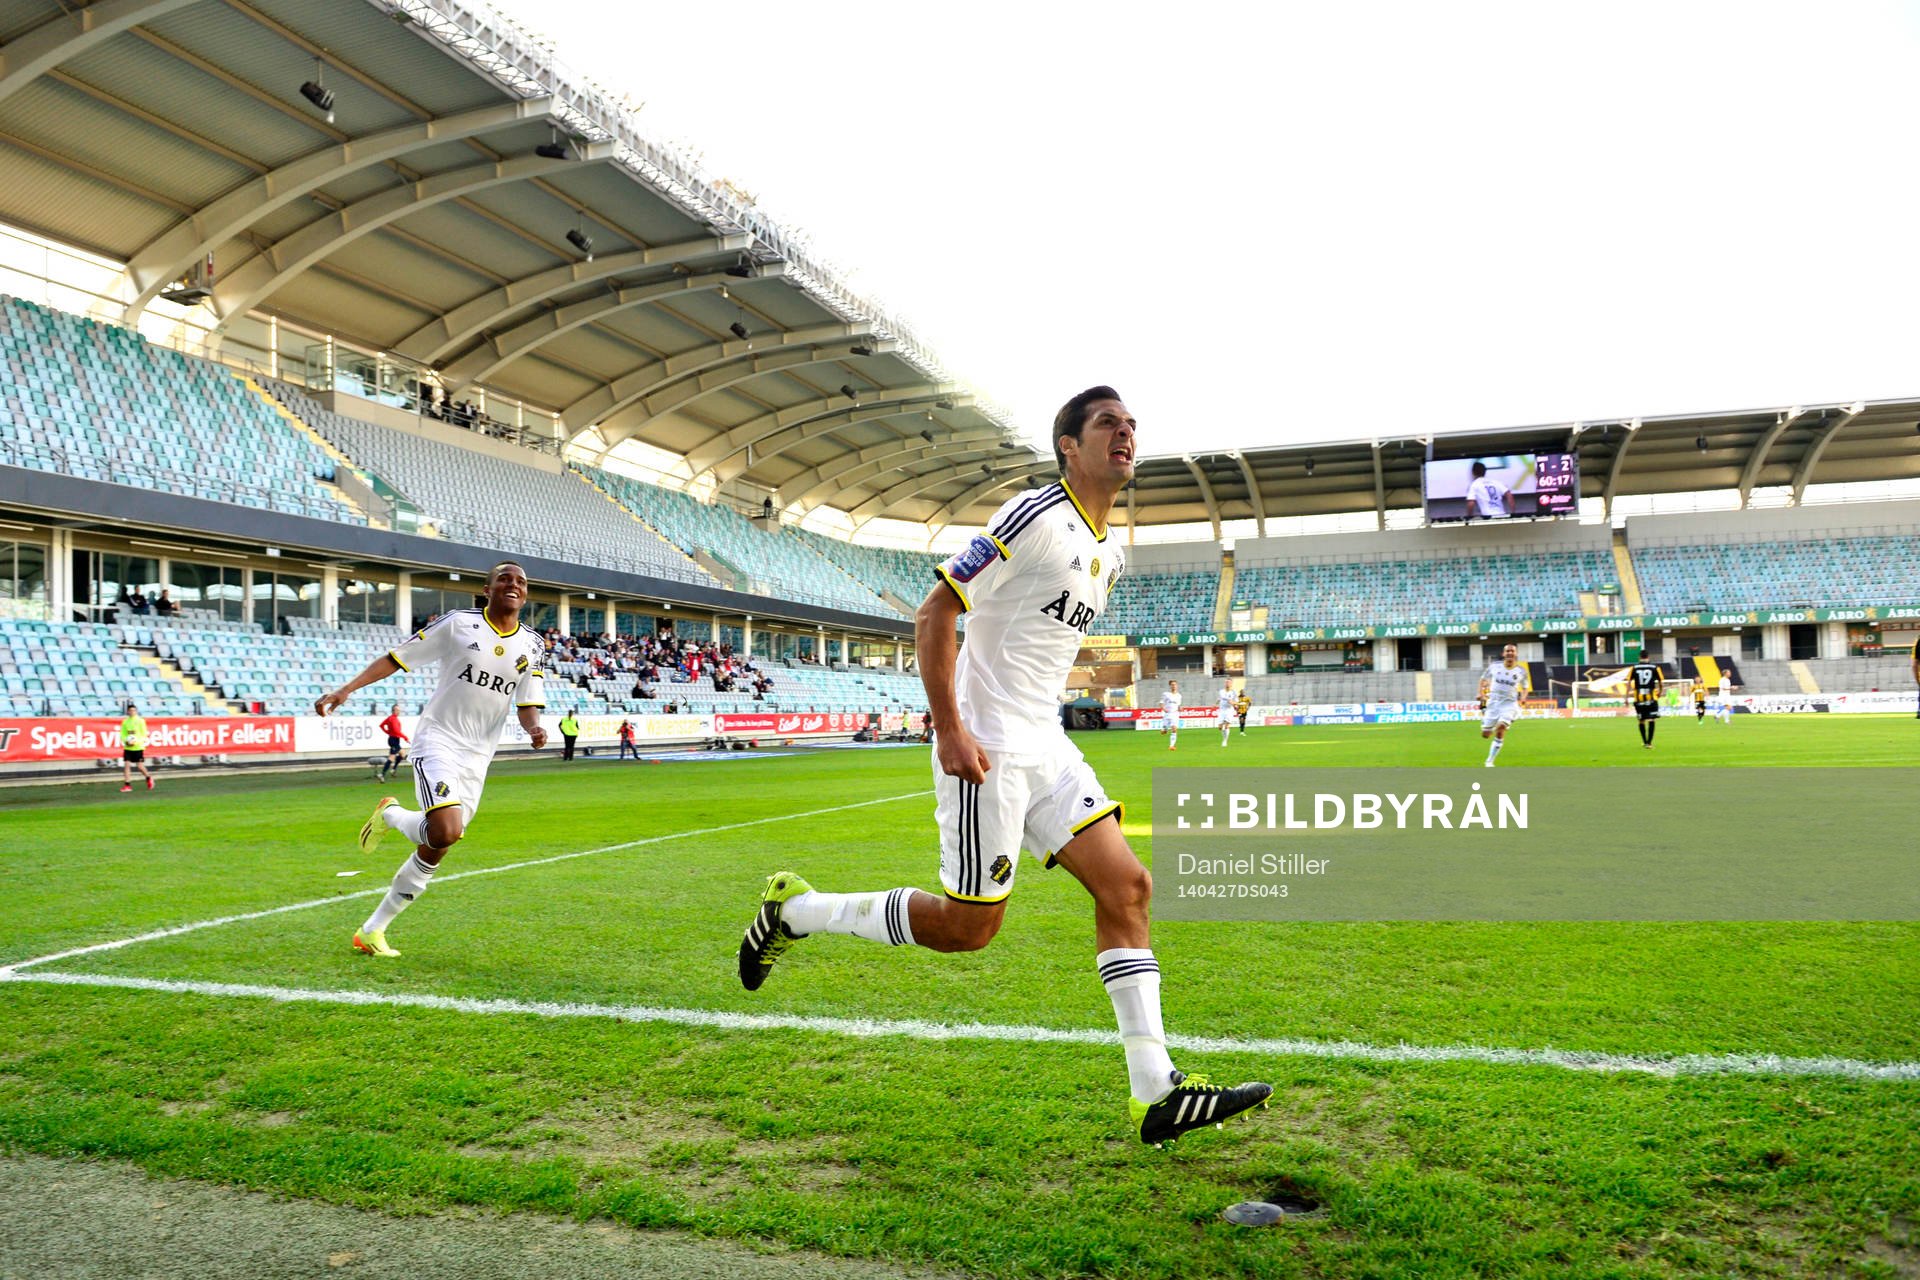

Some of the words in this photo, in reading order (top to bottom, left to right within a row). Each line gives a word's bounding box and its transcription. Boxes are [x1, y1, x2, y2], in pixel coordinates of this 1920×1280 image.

[1539, 462, 1545, 472] 1
[1561, 460, 1570, 471] 2
[1539, 474, 1570, 487] 60:17
[458, 663, 517, 696] ÅBRO
[1635, 669, 1653, 685] 19
[1258, 706, 1309, 717] exceed
[1377, 712, 1459, 723] EHRENBORG
[31, 724, 96, 754] Spela
[100, 724, 123, 748] vi
[217, 724, 229, 745] F
[232, 723, 272, 744] eller
[275, 723, 289, 743] N
[329, 720, 373, 746] higab
